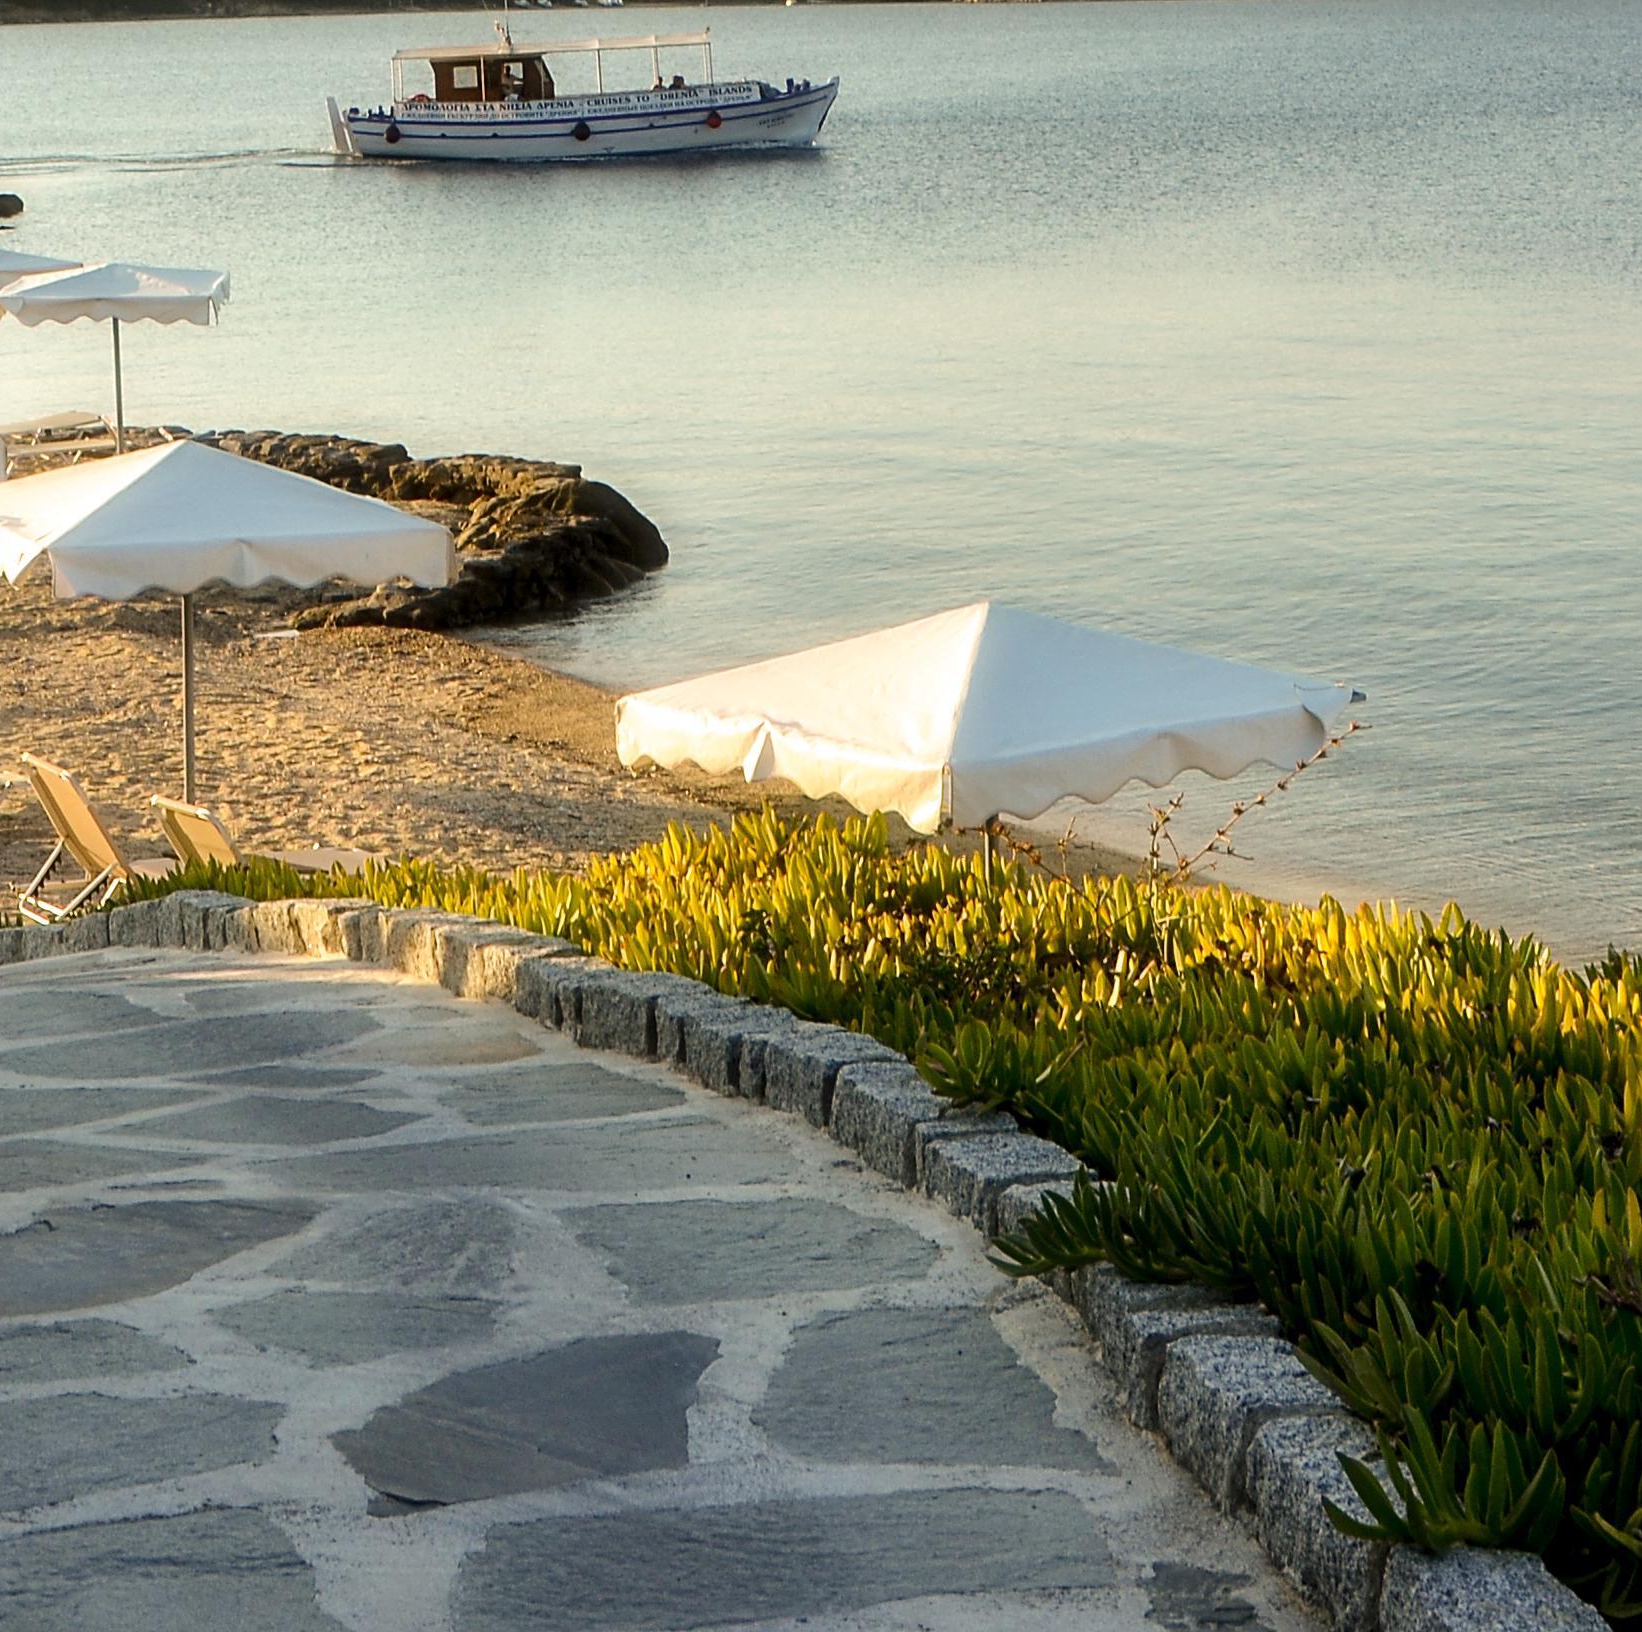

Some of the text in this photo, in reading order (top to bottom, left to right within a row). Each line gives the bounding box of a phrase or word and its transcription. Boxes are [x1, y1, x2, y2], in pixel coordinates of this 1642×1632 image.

[586, 96, 631, 107] CRUISES
[637, 95, 650, 103] TO
[709, 85, 752, 96] ISLANDS
[475, 103, 494, 111] ΣΤΑ
[499, 102, 532, 111] ΝΗΣΙΑ
